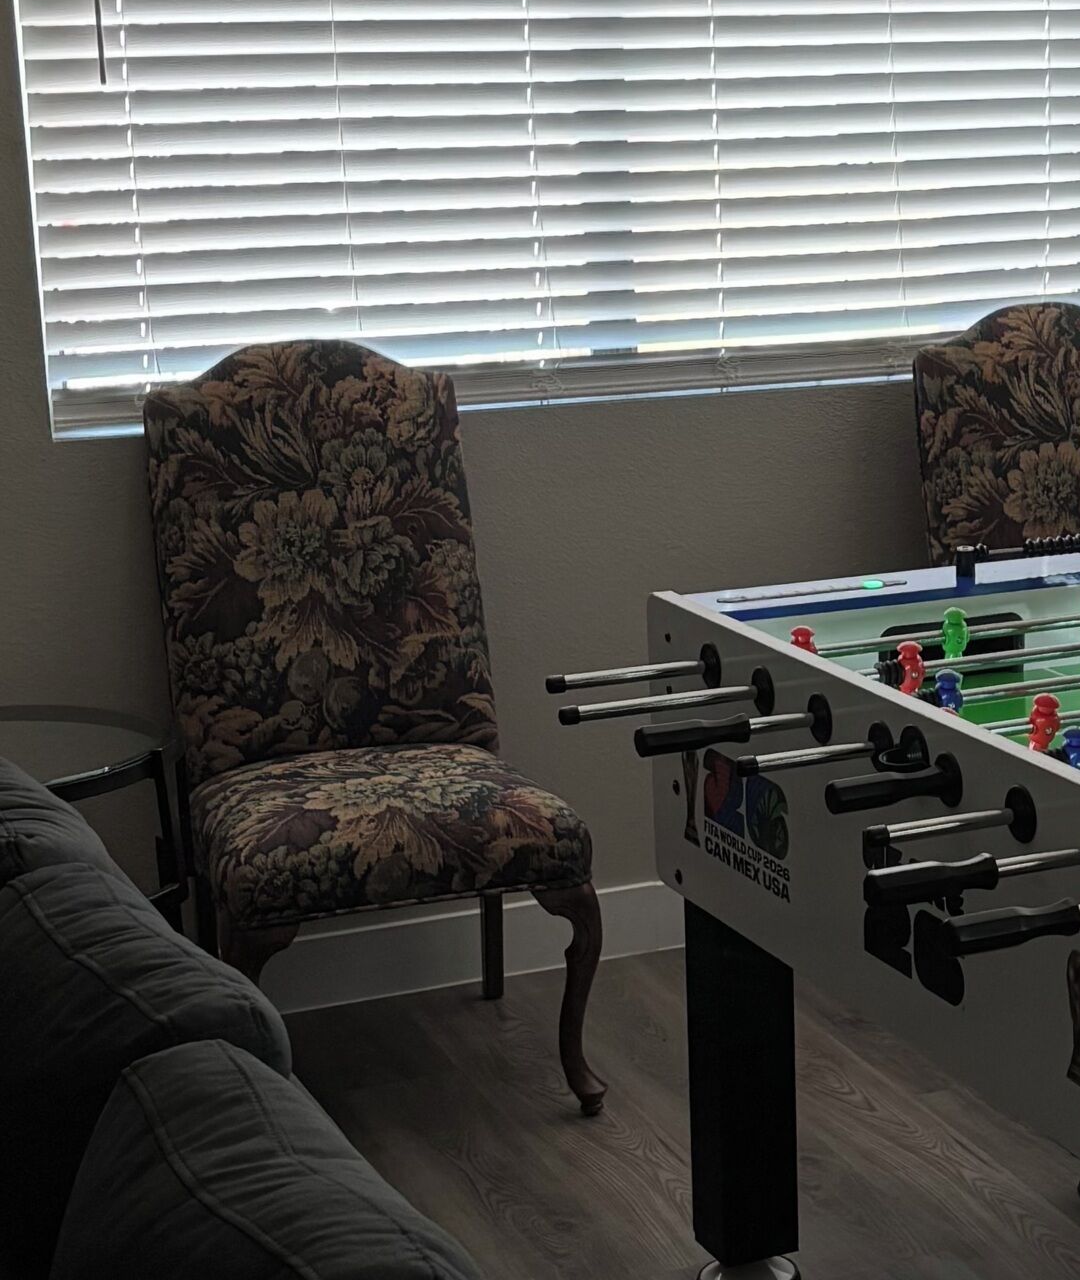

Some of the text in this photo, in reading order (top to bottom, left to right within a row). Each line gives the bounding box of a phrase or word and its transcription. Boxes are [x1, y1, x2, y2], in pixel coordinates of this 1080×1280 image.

[704, 820, 790, 882] FIFA WORLD CUP 2026
[704, 836, 791, 903] CAN MEX USA
